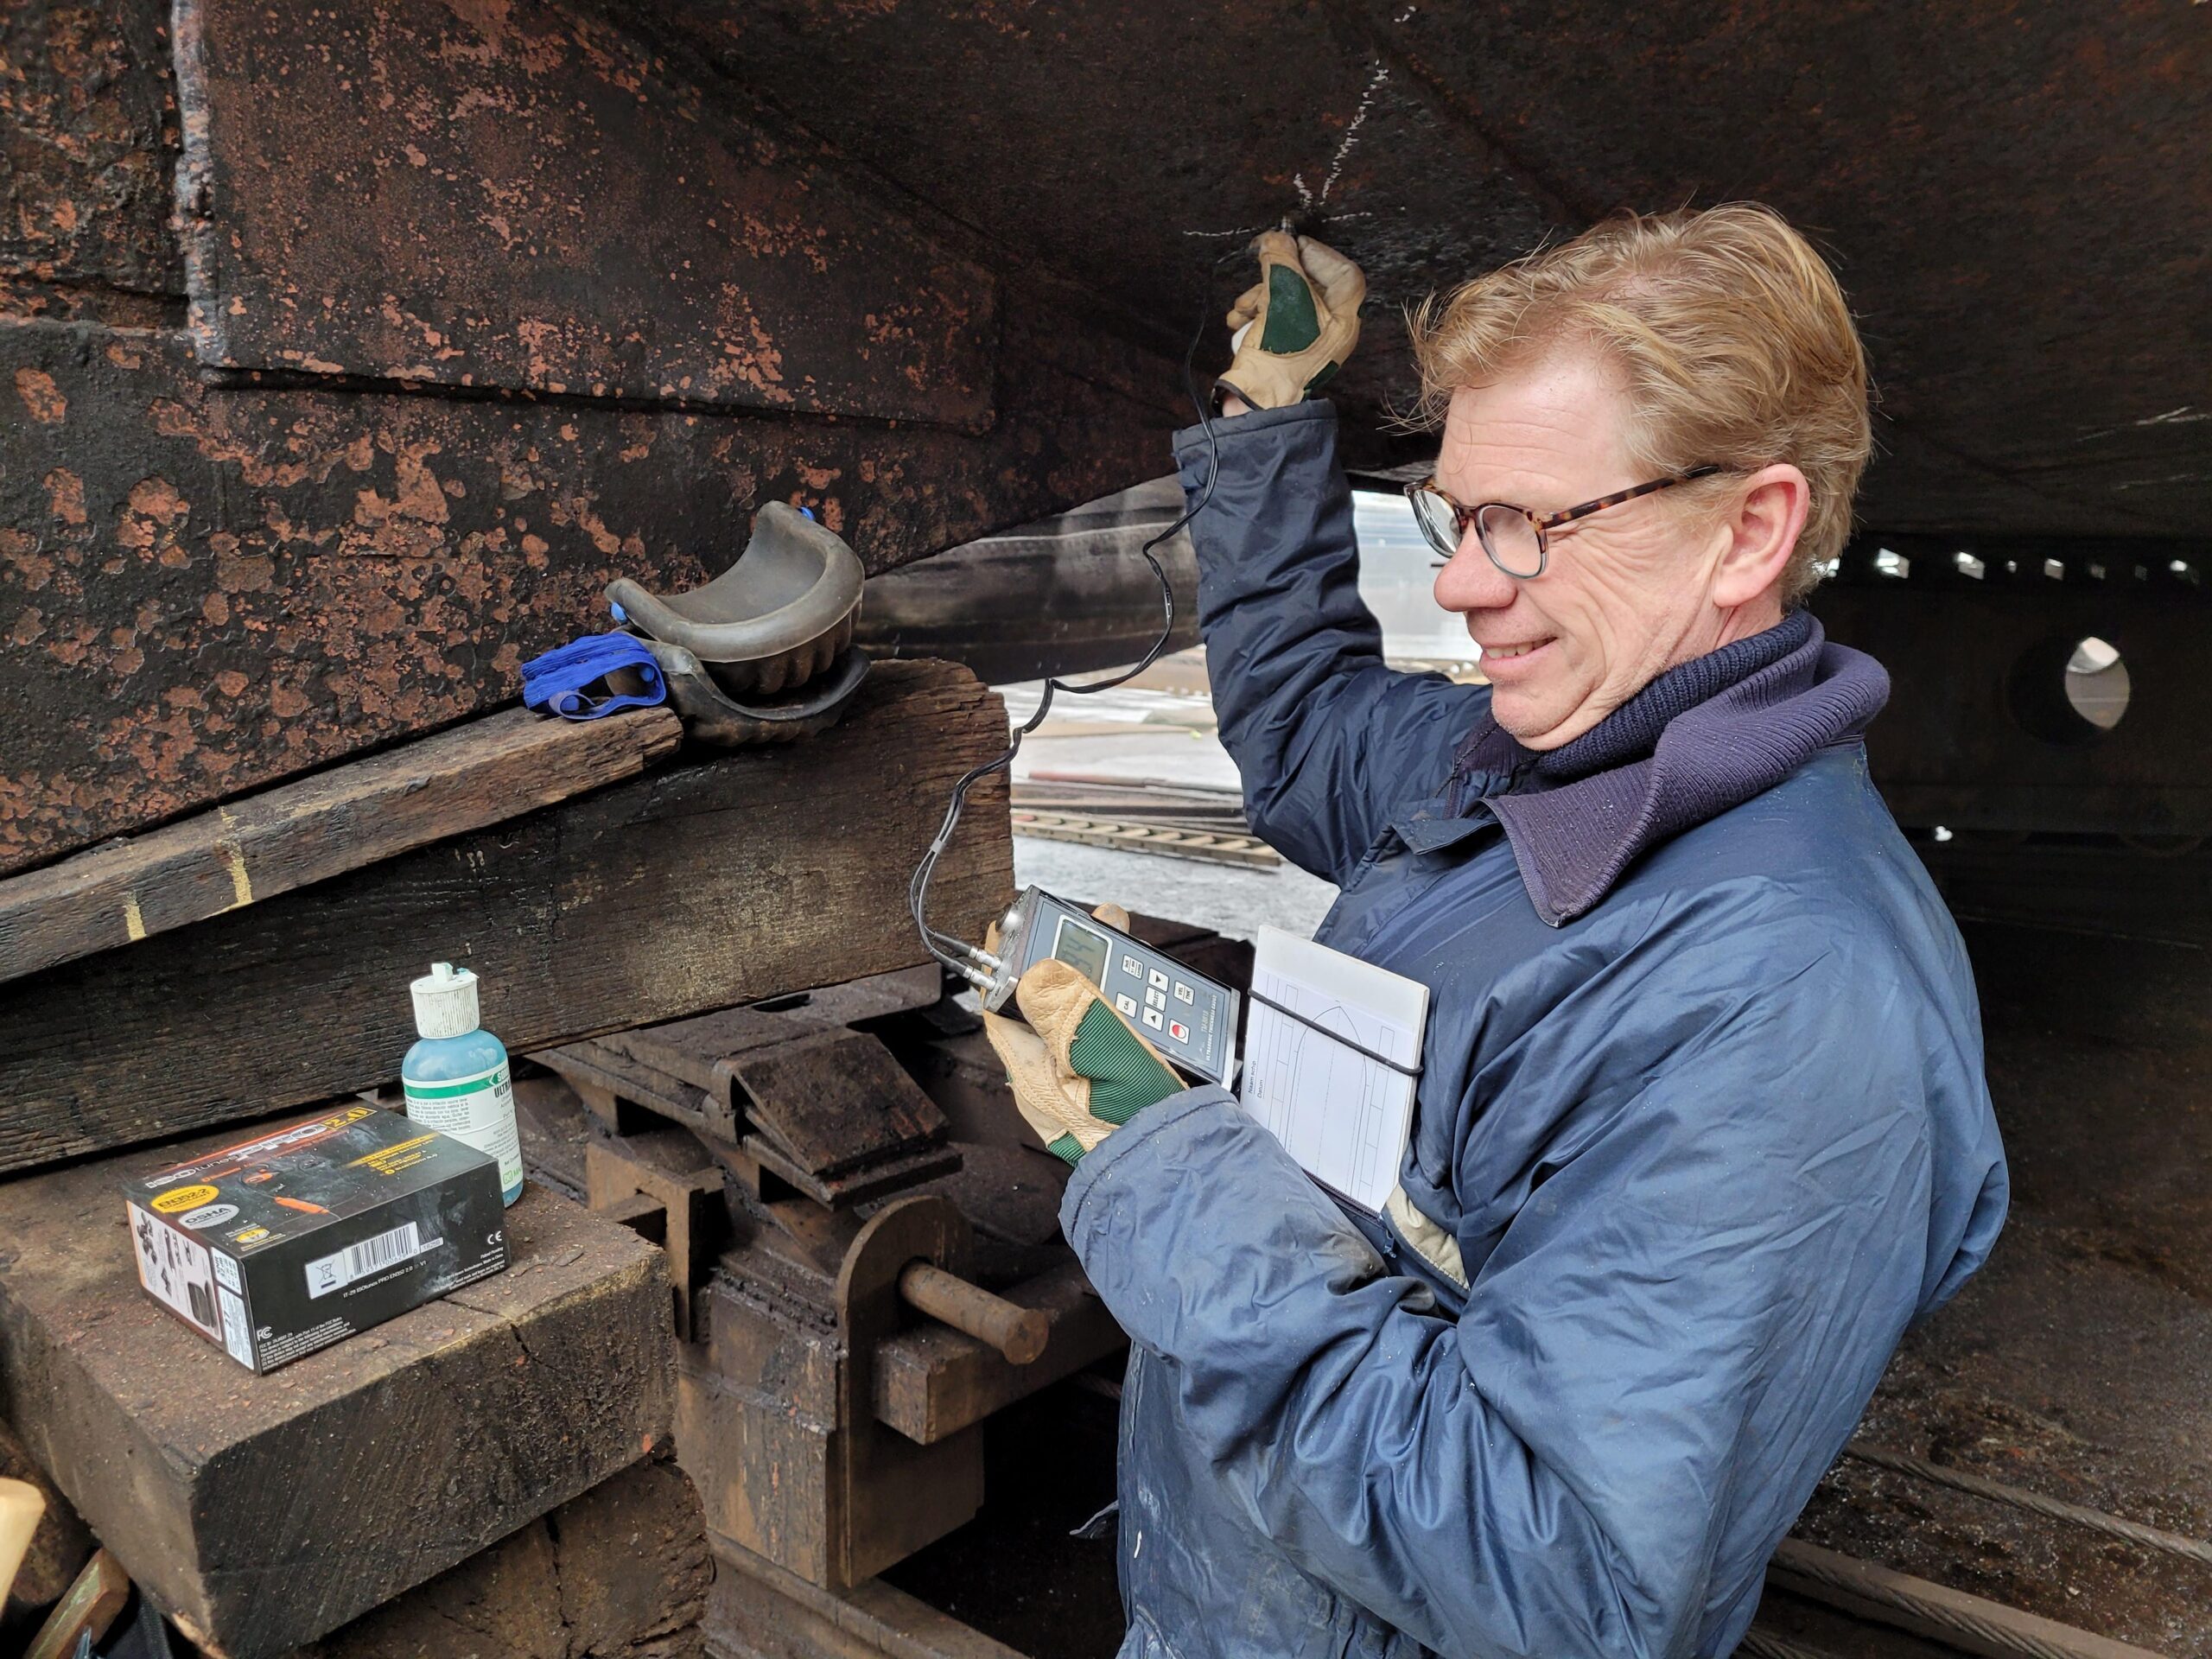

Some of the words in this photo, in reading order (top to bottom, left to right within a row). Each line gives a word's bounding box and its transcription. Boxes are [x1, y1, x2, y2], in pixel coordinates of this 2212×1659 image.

[228, 1123, 327, 1161] PRO
[326, 1108, 369, 1128] 2.0
[158, 1188, 207, 1207] EN352-2
[186, 1207, 230, 1224] OSHA
[486, 1230, 502, 1244] CE
[377, 1274, 389, 1283] PRO
